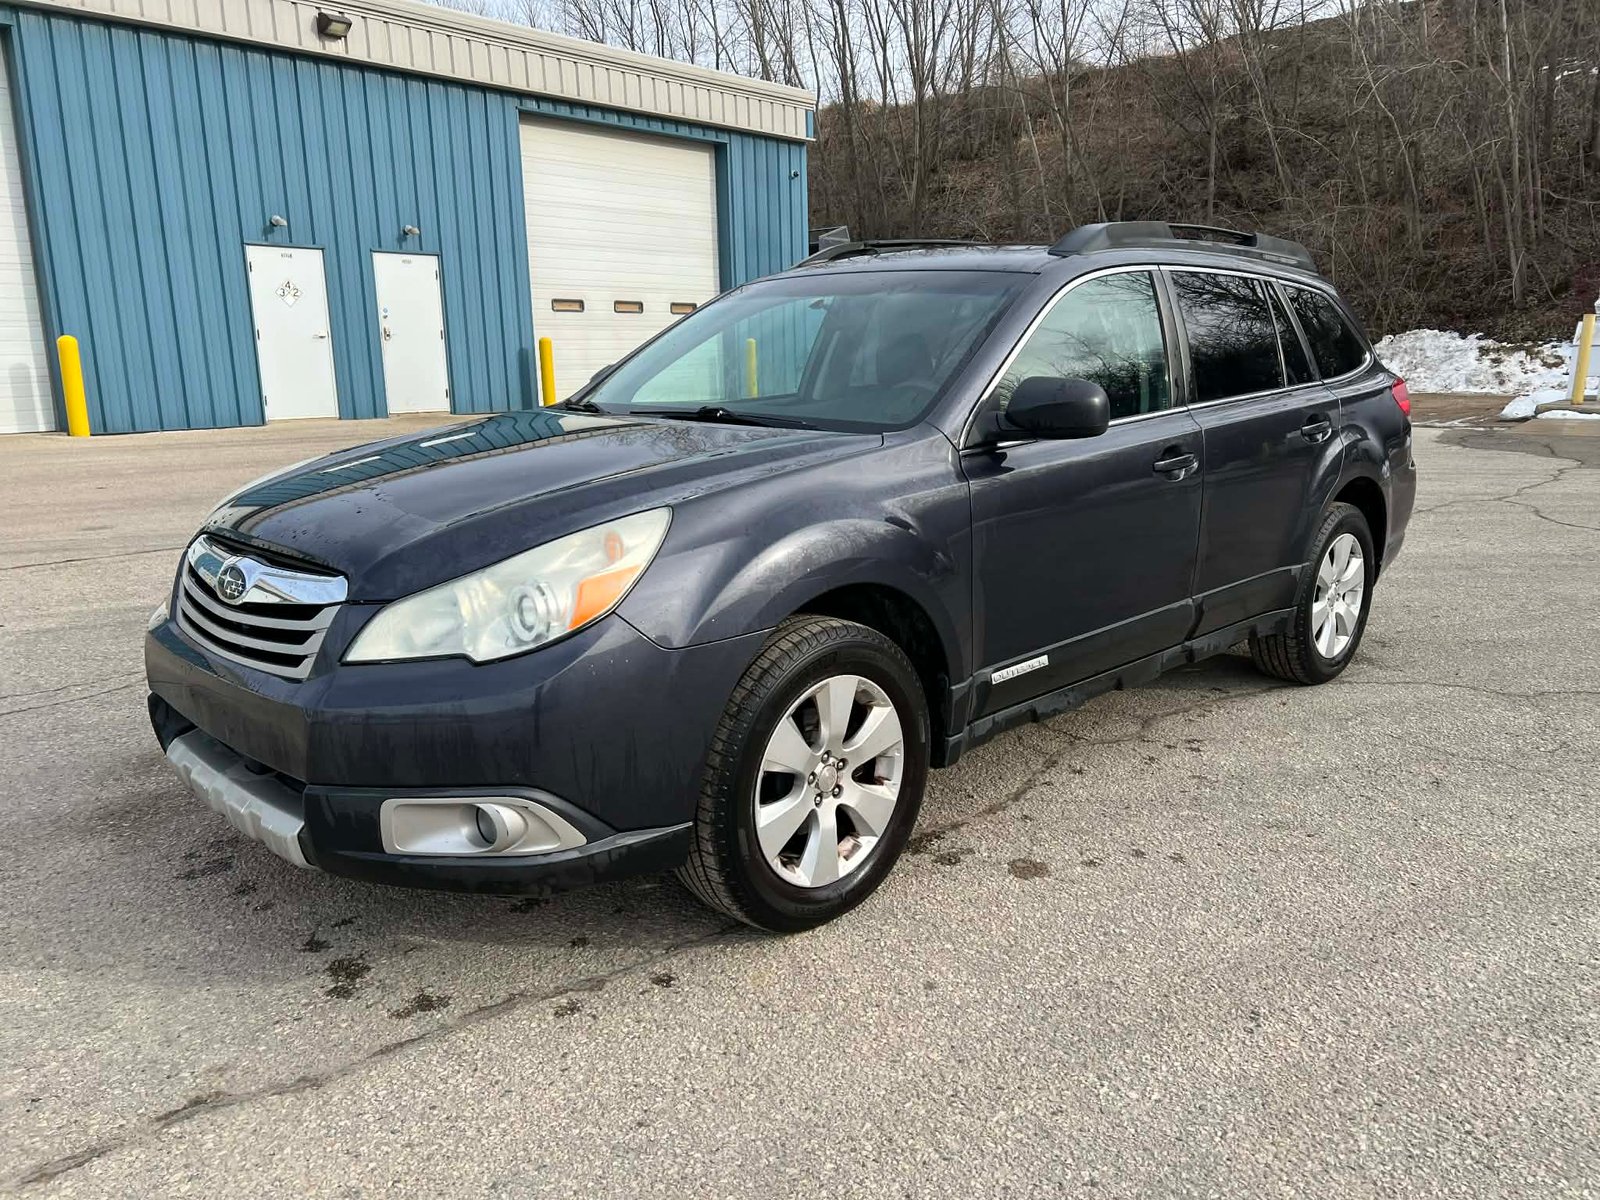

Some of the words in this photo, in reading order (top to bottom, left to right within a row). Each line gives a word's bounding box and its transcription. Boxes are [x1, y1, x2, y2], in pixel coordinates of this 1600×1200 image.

[284, 281, 291, 290] 4
[279, 287, 286, 297] 3
[293, 288, 300, 297] 2
[992, 656, 1047, 683] OUTBACK
